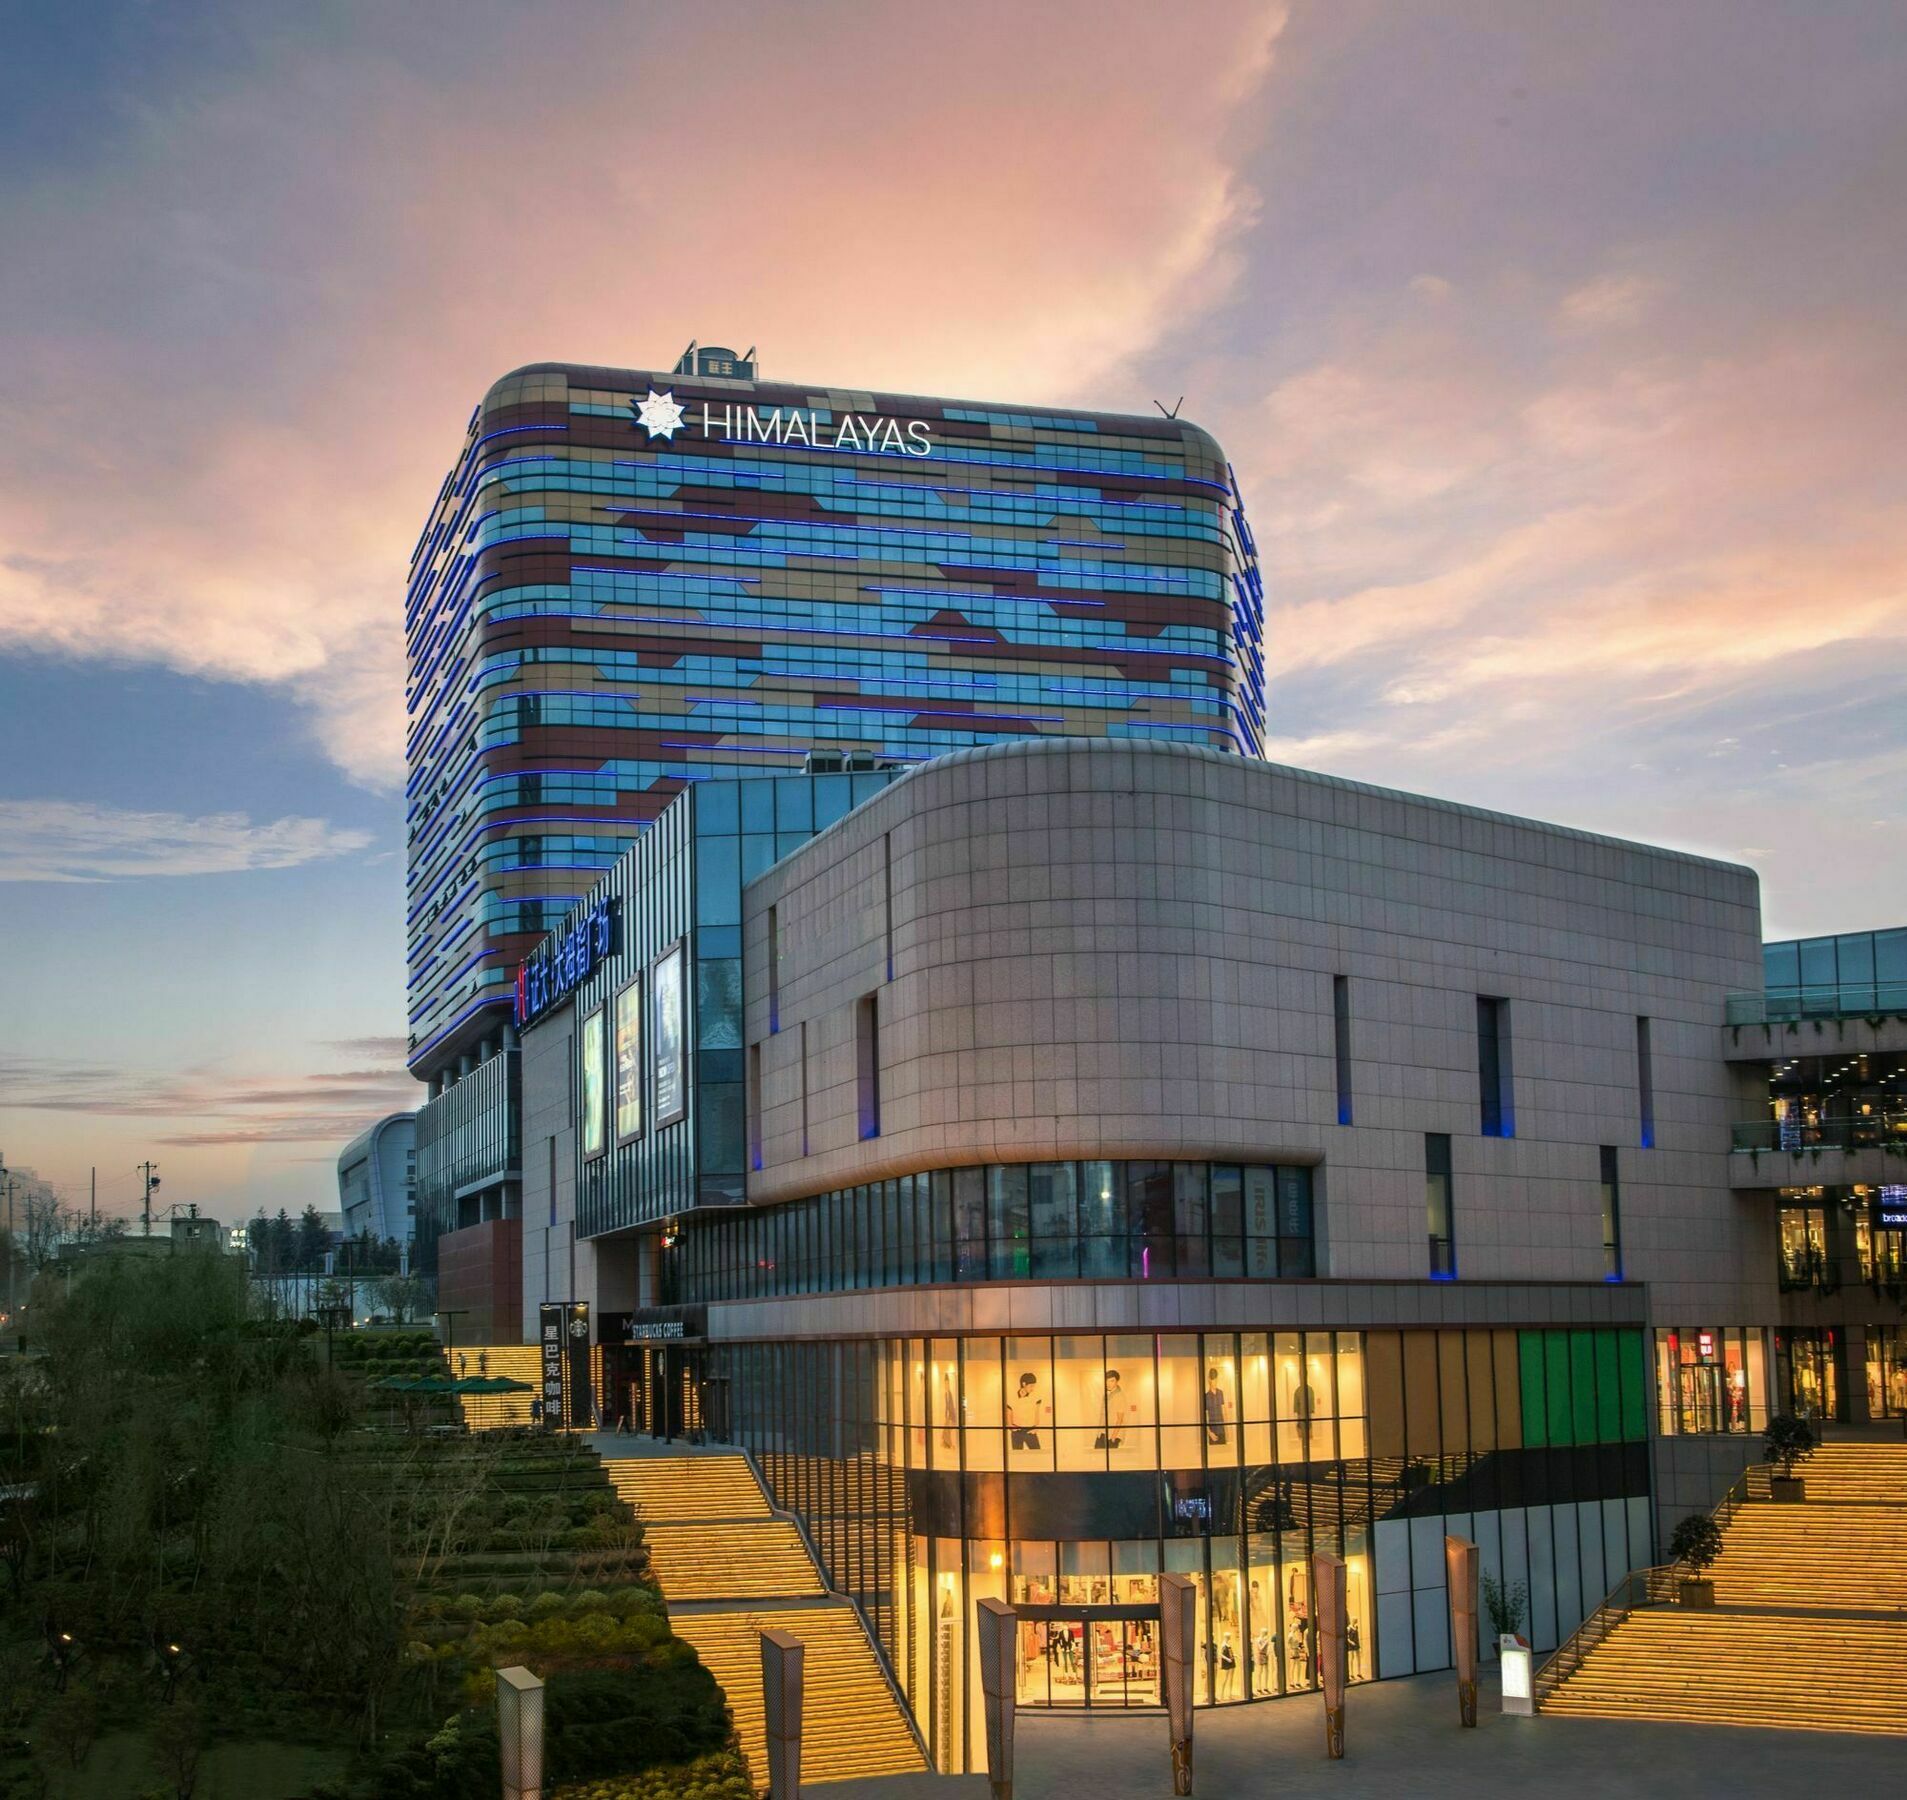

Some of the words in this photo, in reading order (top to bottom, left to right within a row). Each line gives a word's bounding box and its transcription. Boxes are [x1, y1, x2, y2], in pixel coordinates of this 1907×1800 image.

[703, 402, 931, 456] HIMALAYAS
[632, 1323, 662, 1339] STARBUCKS
[663, 1321, 684, 1338] COFFEE
[544, 1325, 562, 1415] 星巴克咖啡
